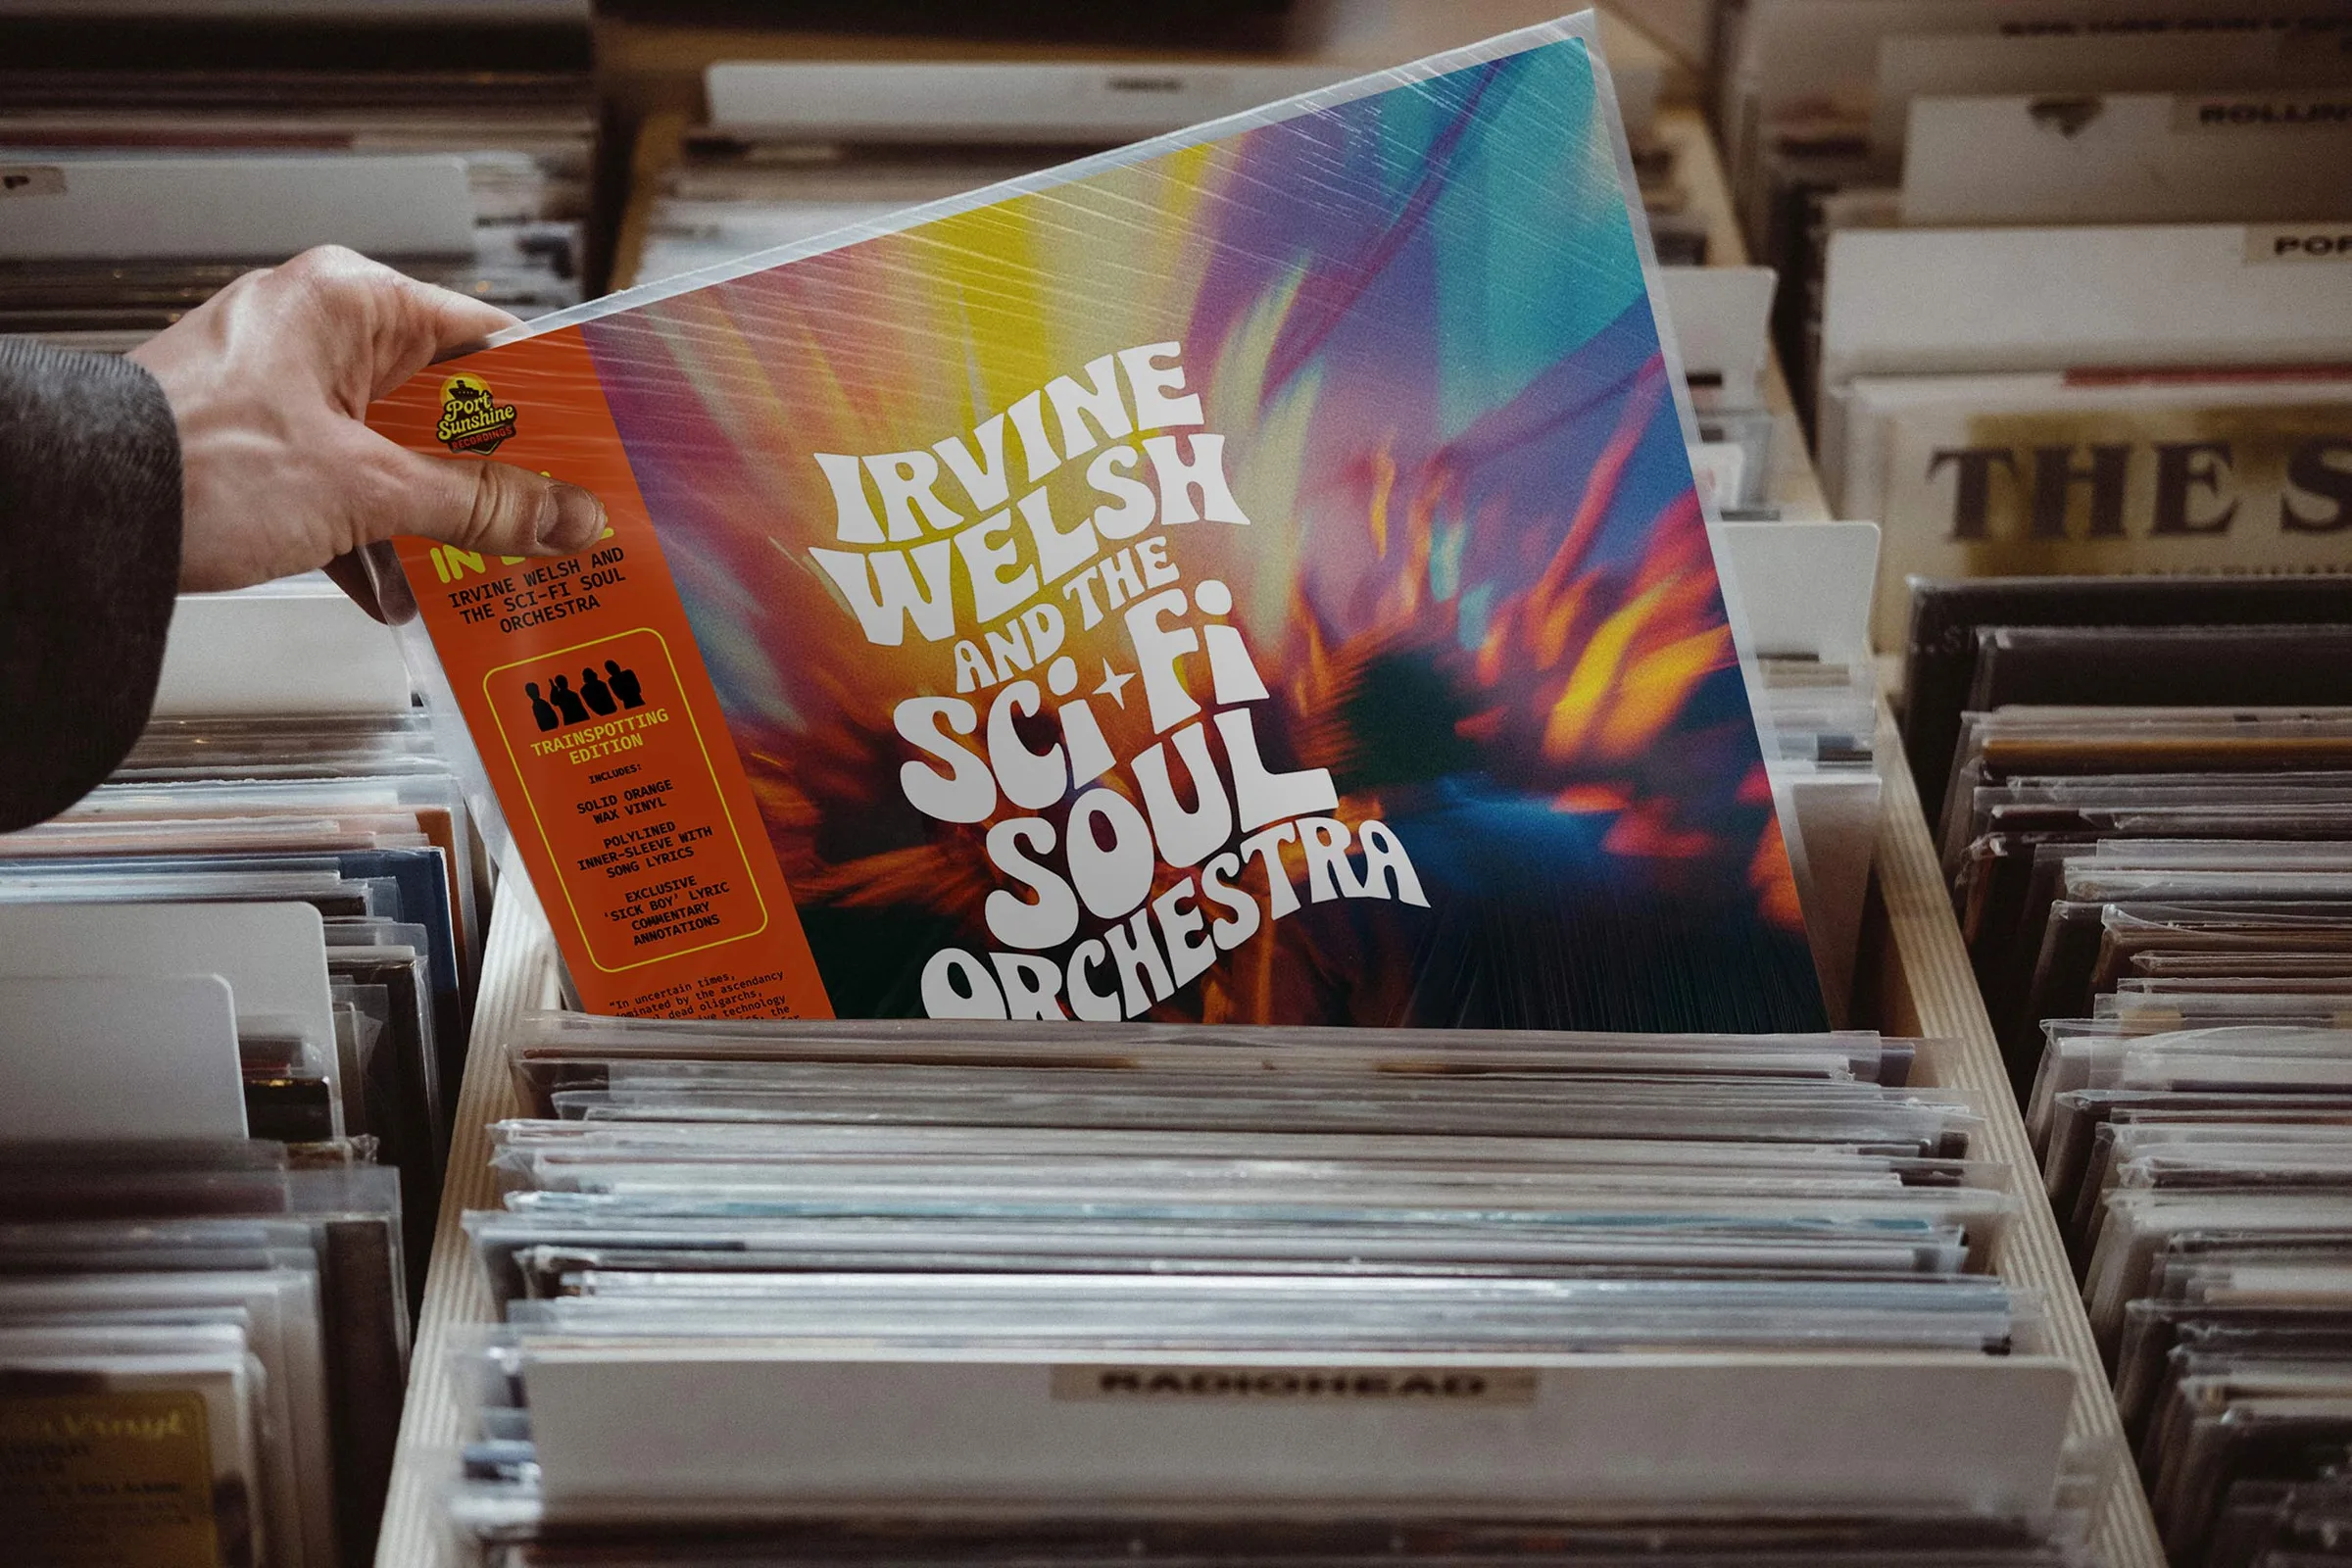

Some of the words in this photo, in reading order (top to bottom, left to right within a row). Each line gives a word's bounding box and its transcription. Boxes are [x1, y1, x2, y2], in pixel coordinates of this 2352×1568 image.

[444, 391, 491, 422] Port
[438, 406, 514, 441] Sunshine
[452, 425, 513, 450] RECORDINGS
[813, 341, 1204, 544] IRVINE
[1925, 441, 2240, 541] THE
[808, 432, 1250, 647] WELSH
[448, 577, 516, 609] IRVINE
[523, 559, 581, 587] WELSH
[591, 547, 625, 568] AND
[460, 603, 496, 625] THE
[503, 581, 571, 612] SCI-FI
[580, 567, 627, 592] SOUL
[500, 594, 601, 634] ORCHESTRA
[955, 602, 1065, 694] AND
[1062, 535, 1180, 632] THE
[530, 708, 669, 758] TRAINSPOTTING
[568, 732, 644, 765] EDITION
[589, 763, 642, 785] INCLUDES:
[576, 794, 618, 814] SOLID
[623, 779, 674, 802] ORANGE
[592, 809, 619, 825] WAX
[624, 797, 667, 816] VINYL
[603, 820, 676, 850] POLYLINED
[984, 707, 1340, 950] SOUL
[576, 836, 674, 871] INNER-SLEEVE
[678, 825, 713, 844] WITH
[606, 860, 641, 879] SONG
[645, 846, 695, 869] LYRICS
[624, 874, 698, 904] EXCLUSIVE
[688, 881, 731, 901] LYRIC
[631, 901, 710, 932] COMMENTARY
[633, 913, 721, 947] ANNOTATIONS
[921, 815, 1432, 1021] ORCHESTRA
[634, 983, 693, 1005] uncertain
[697, 972, 737, 989] times,
[668, 1005, 695, 1019] dead
[699, 990, 763, 1012] oligarchs,
[676, 996, 690, 1007] by
[695, 988, 715, 1001] the
[720, 970, 785, 995] ascendancy
[722, 994, 787, 1018] technology
[770, 1004, 791, 1017] the
[1099, 1372, 1488, 1397] RADIOHEAD
